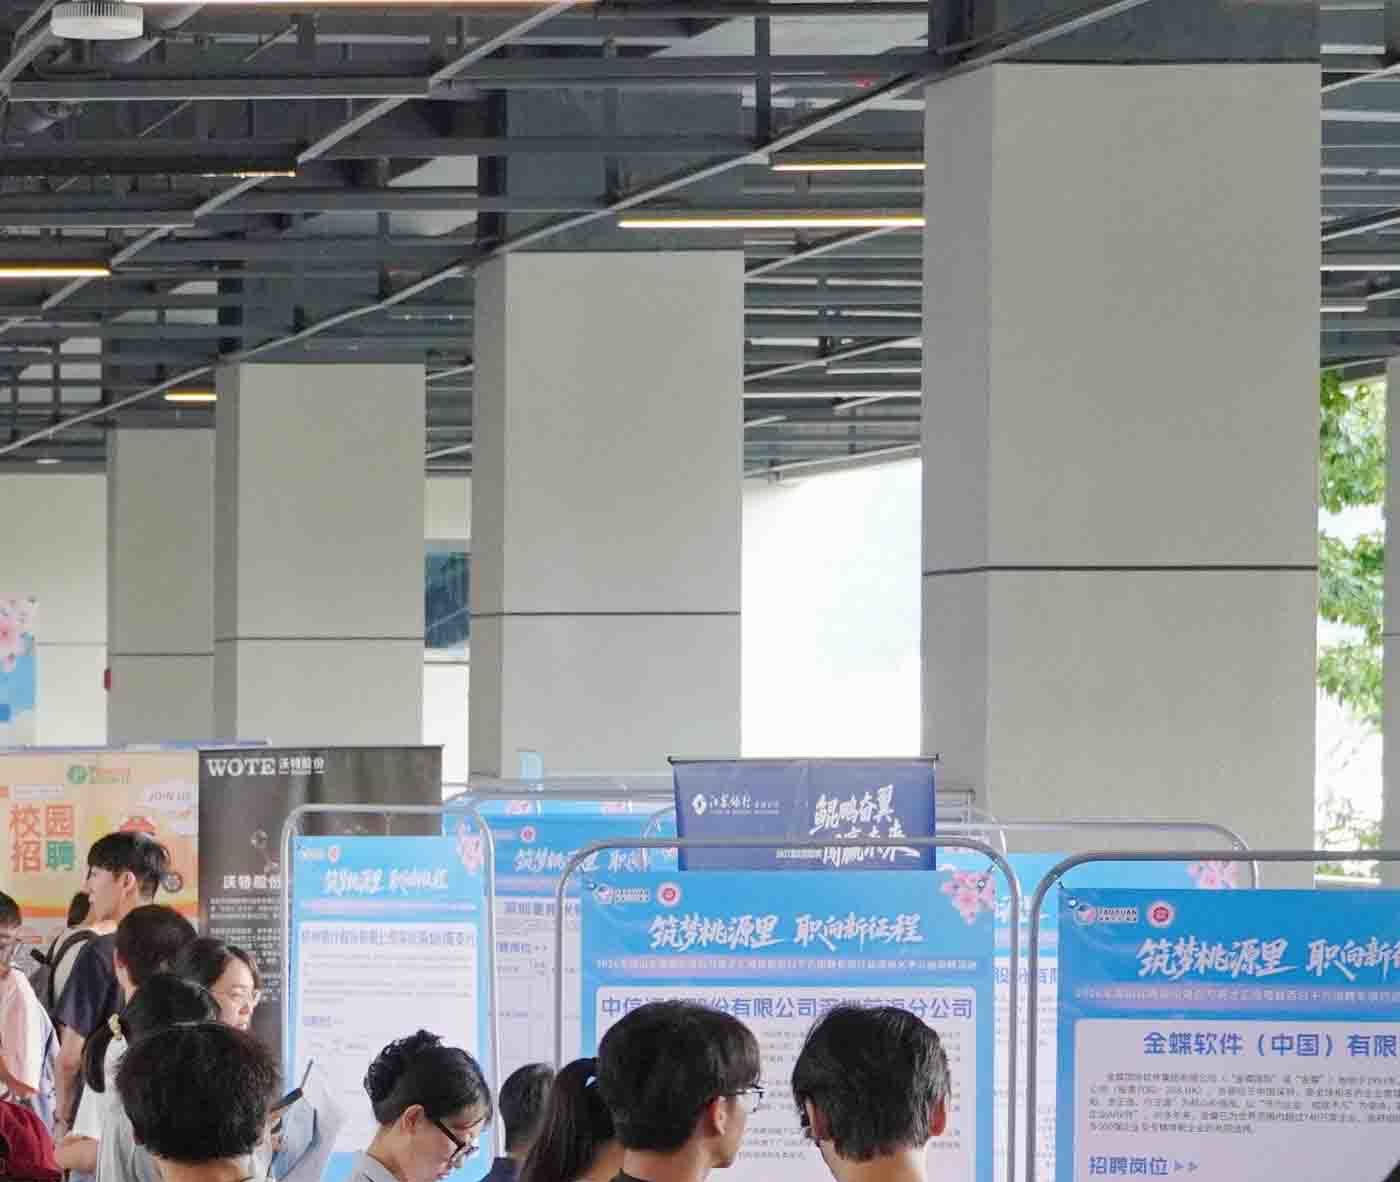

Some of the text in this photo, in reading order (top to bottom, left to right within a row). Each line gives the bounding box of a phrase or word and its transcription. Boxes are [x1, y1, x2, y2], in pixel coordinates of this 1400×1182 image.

[207, 757, 275, 777] WOTE
[10, 803, 74, 837] 校园
[11, 840, 74, 873] 招聘
[648, 911, 925, 951] 筑梦桃源里 职向新征程
[1136, 935, 1297, 981] 筑梦桃源里
[1143, 1030, 1400, 1058] 金蝶软件（中国）有限
[1089, 1156, 1168, 1176] 招聘岗位
